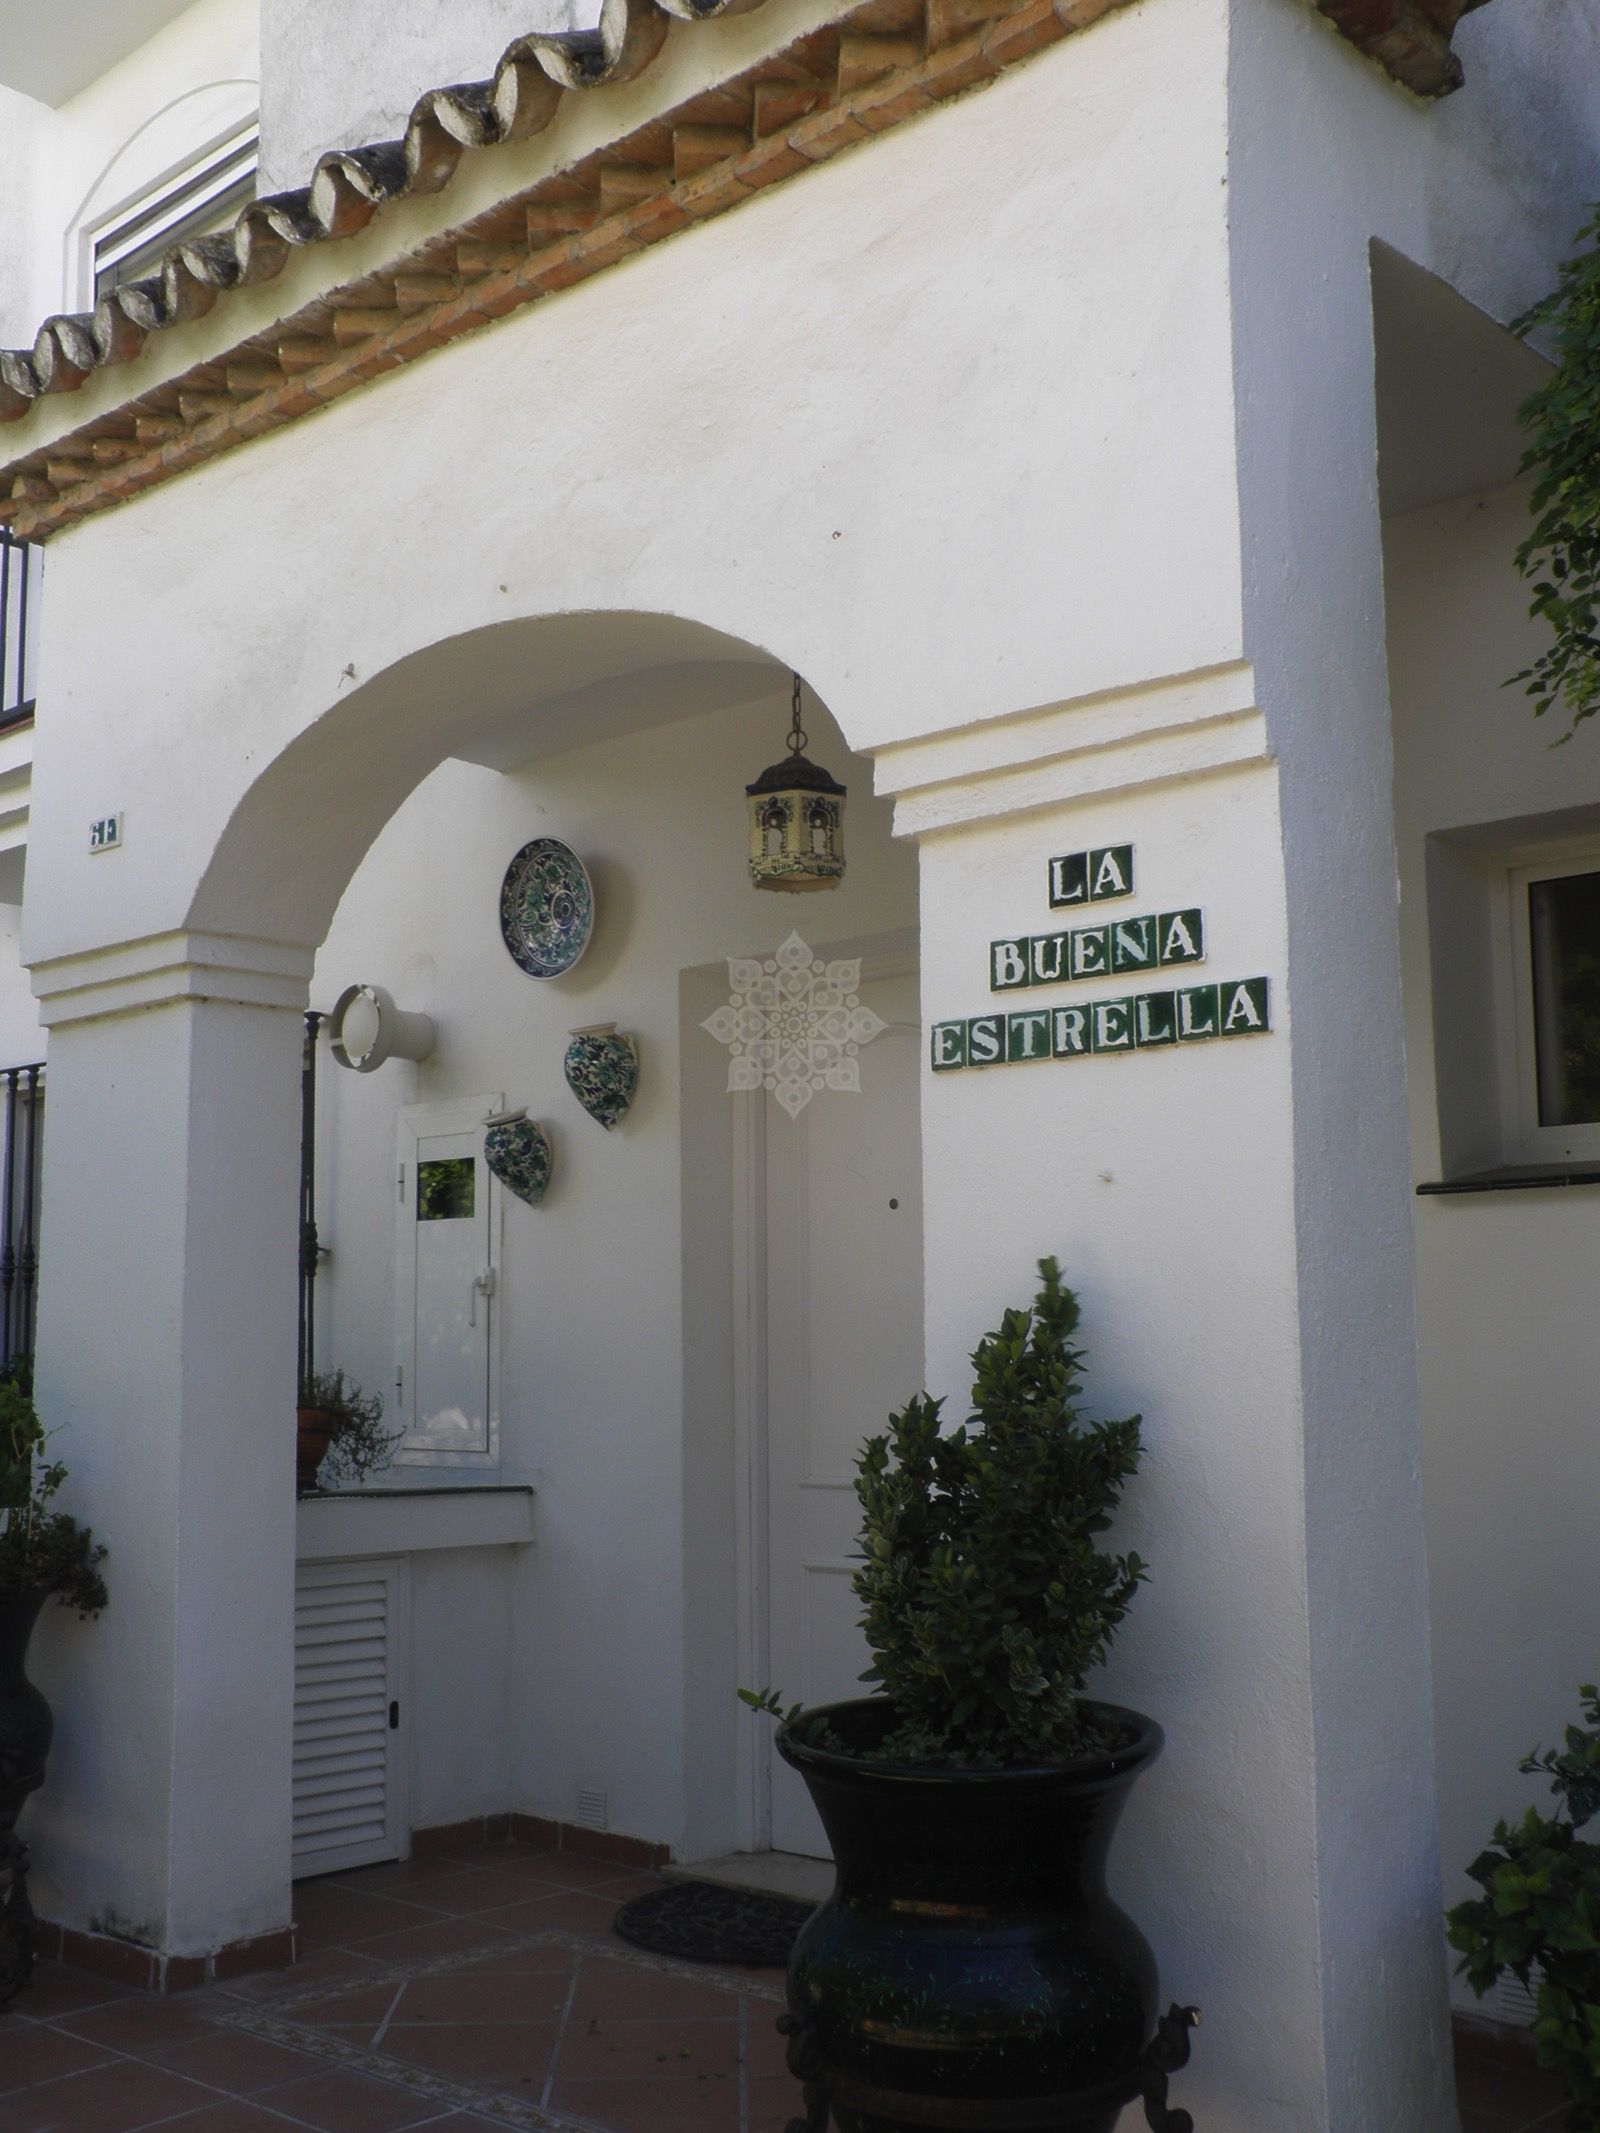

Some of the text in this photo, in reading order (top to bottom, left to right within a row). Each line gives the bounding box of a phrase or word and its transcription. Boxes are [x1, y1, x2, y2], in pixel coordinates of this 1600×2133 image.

[1051, 851, 1127, 901] LA
[994, 914, 1198, 987] BUENA
[932, 984, 1263, 1066] ESTRELLA
